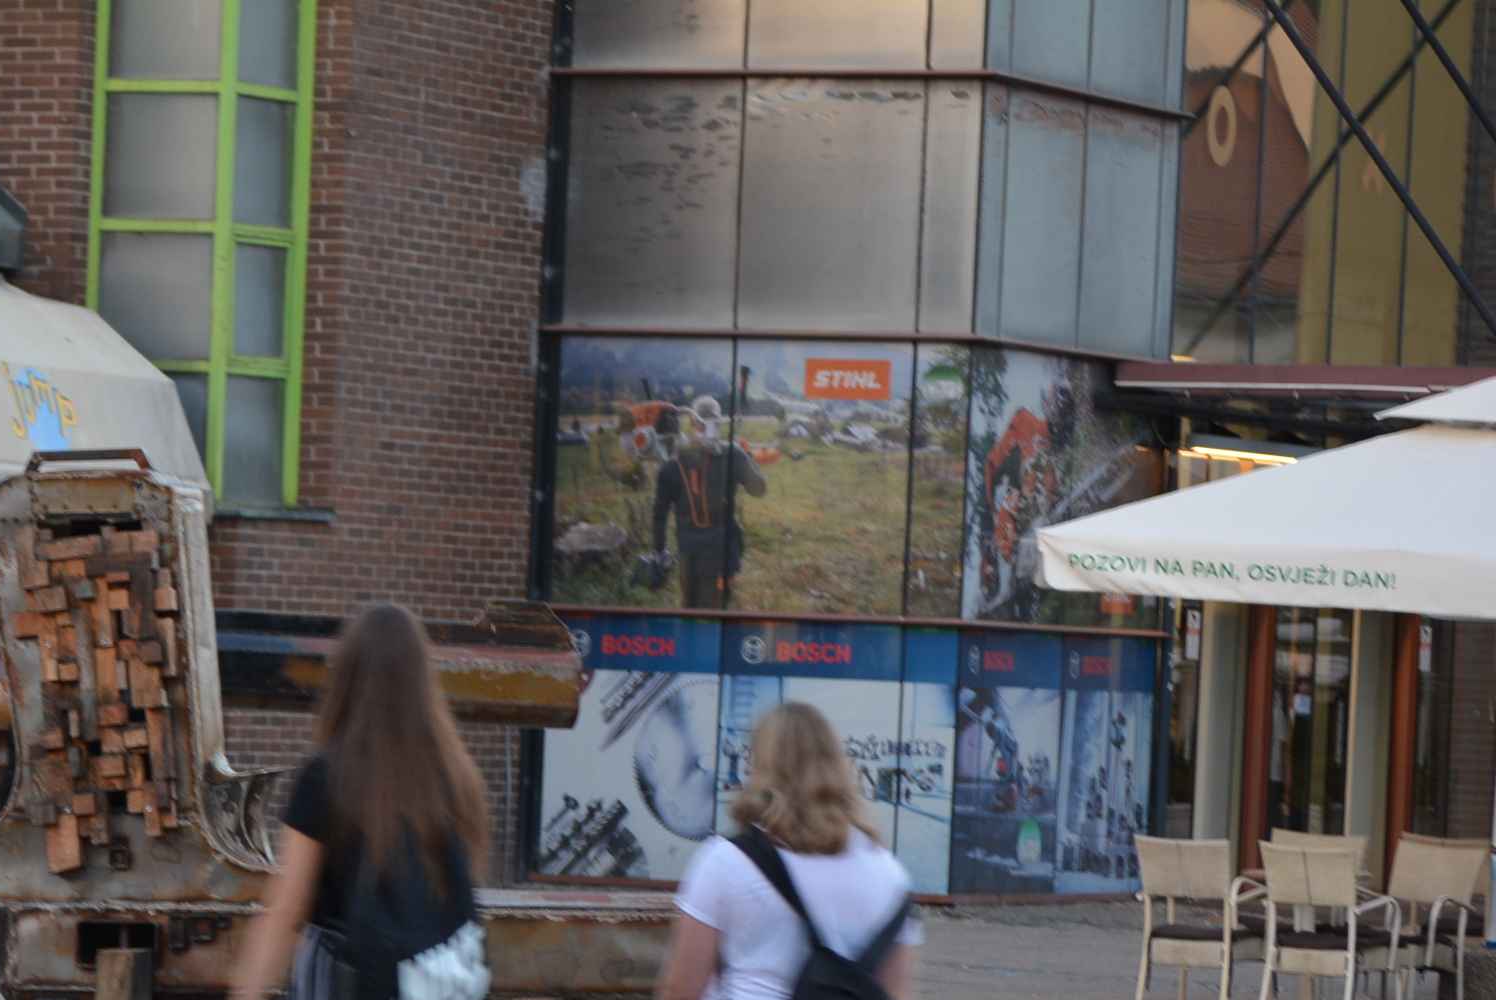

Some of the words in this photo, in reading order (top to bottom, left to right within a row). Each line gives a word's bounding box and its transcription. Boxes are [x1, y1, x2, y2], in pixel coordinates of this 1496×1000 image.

[813, 369, 881, 389] STIHL
[1068, 552, 1147, 574] POZOVI
[1155, 558, 1185, 576] NA
[1192, 561, 1240, 582] PAN,
[1248, 563, 1336, 587] OSVJEŽI
[1343, 569, 1397, 590] DAN!
[600, 634, 676, 657] BOSCH
[776, 640, 852, 664] BOSCH
